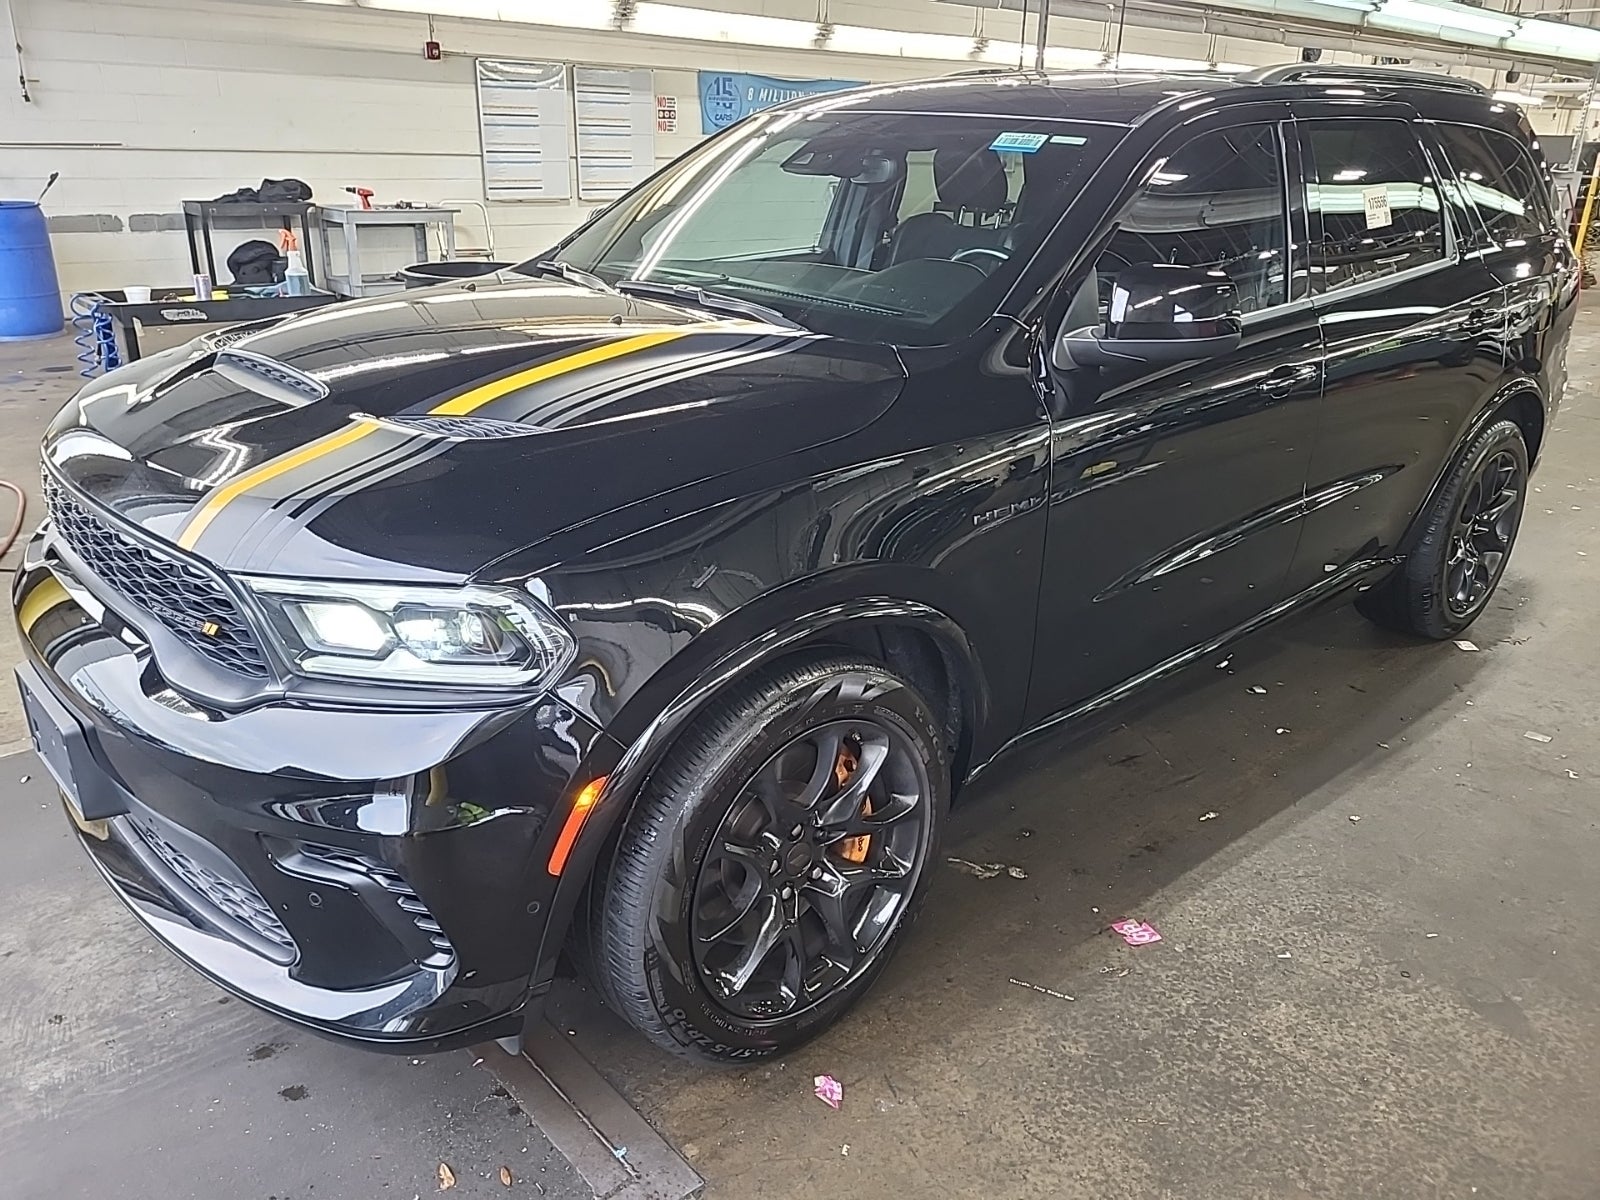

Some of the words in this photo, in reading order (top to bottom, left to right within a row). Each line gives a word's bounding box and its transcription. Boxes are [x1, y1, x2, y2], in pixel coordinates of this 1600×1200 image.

[747, 87, 754, 101] 8
[758, 87, 804, 102] MILLION
[657, 96, 667, 108] NO
[714, 113, 733, 121] CARS
[657, 120, 667, 132] NO
[973, 497, 1041, 525] HEMI
